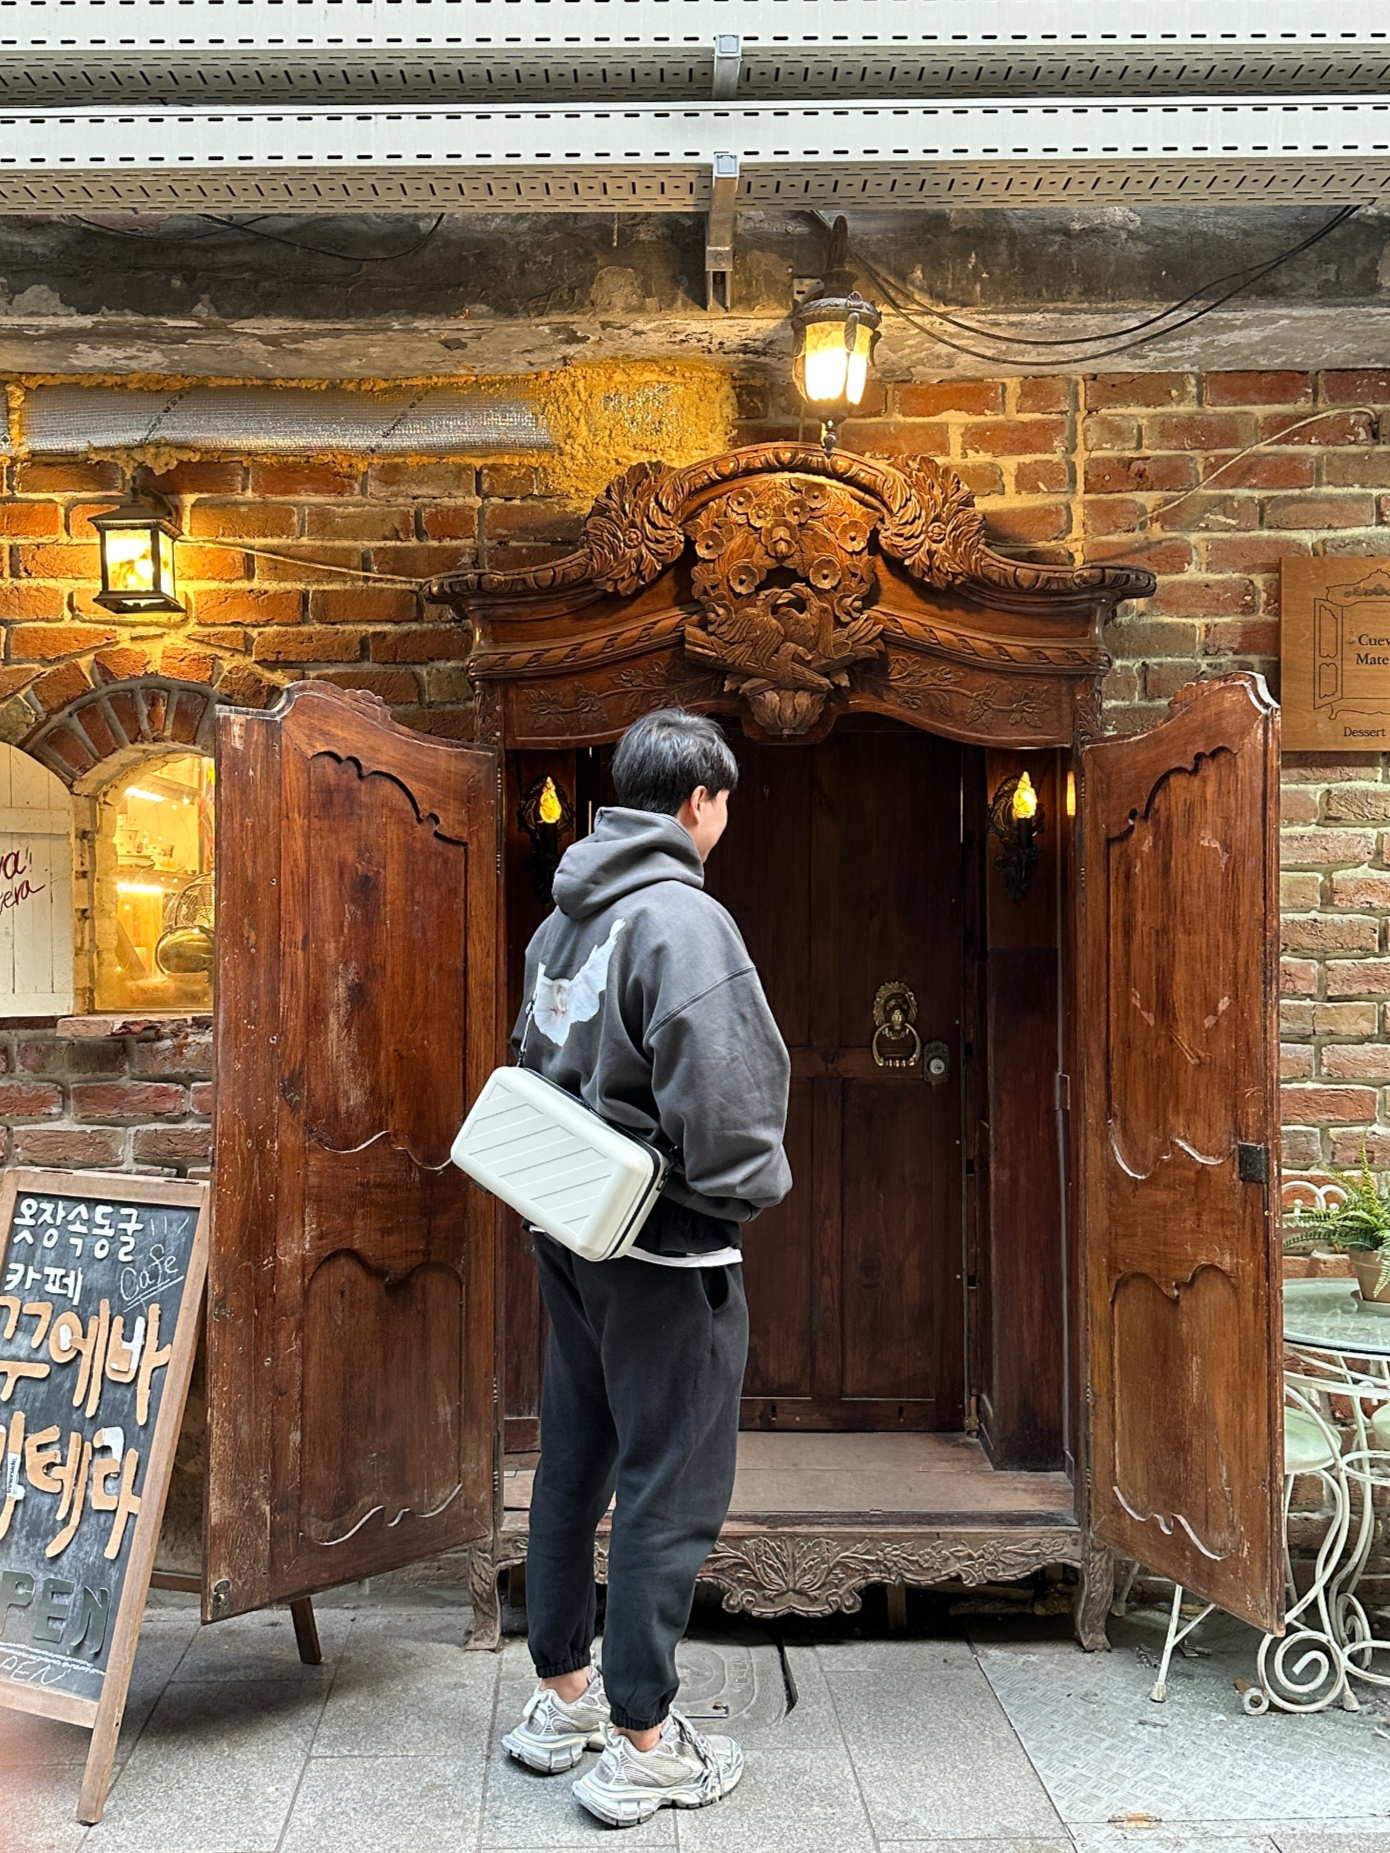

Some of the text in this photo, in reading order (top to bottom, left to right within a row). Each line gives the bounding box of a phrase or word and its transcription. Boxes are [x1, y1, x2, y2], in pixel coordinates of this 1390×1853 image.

[1343, 726, 1386, 737] Dessert
[13, 1198, 144, 1262] 옷장속동굴
[4, 1263, 83, 1306] 카페
[120, 1244, 179, 1301] Cafe
